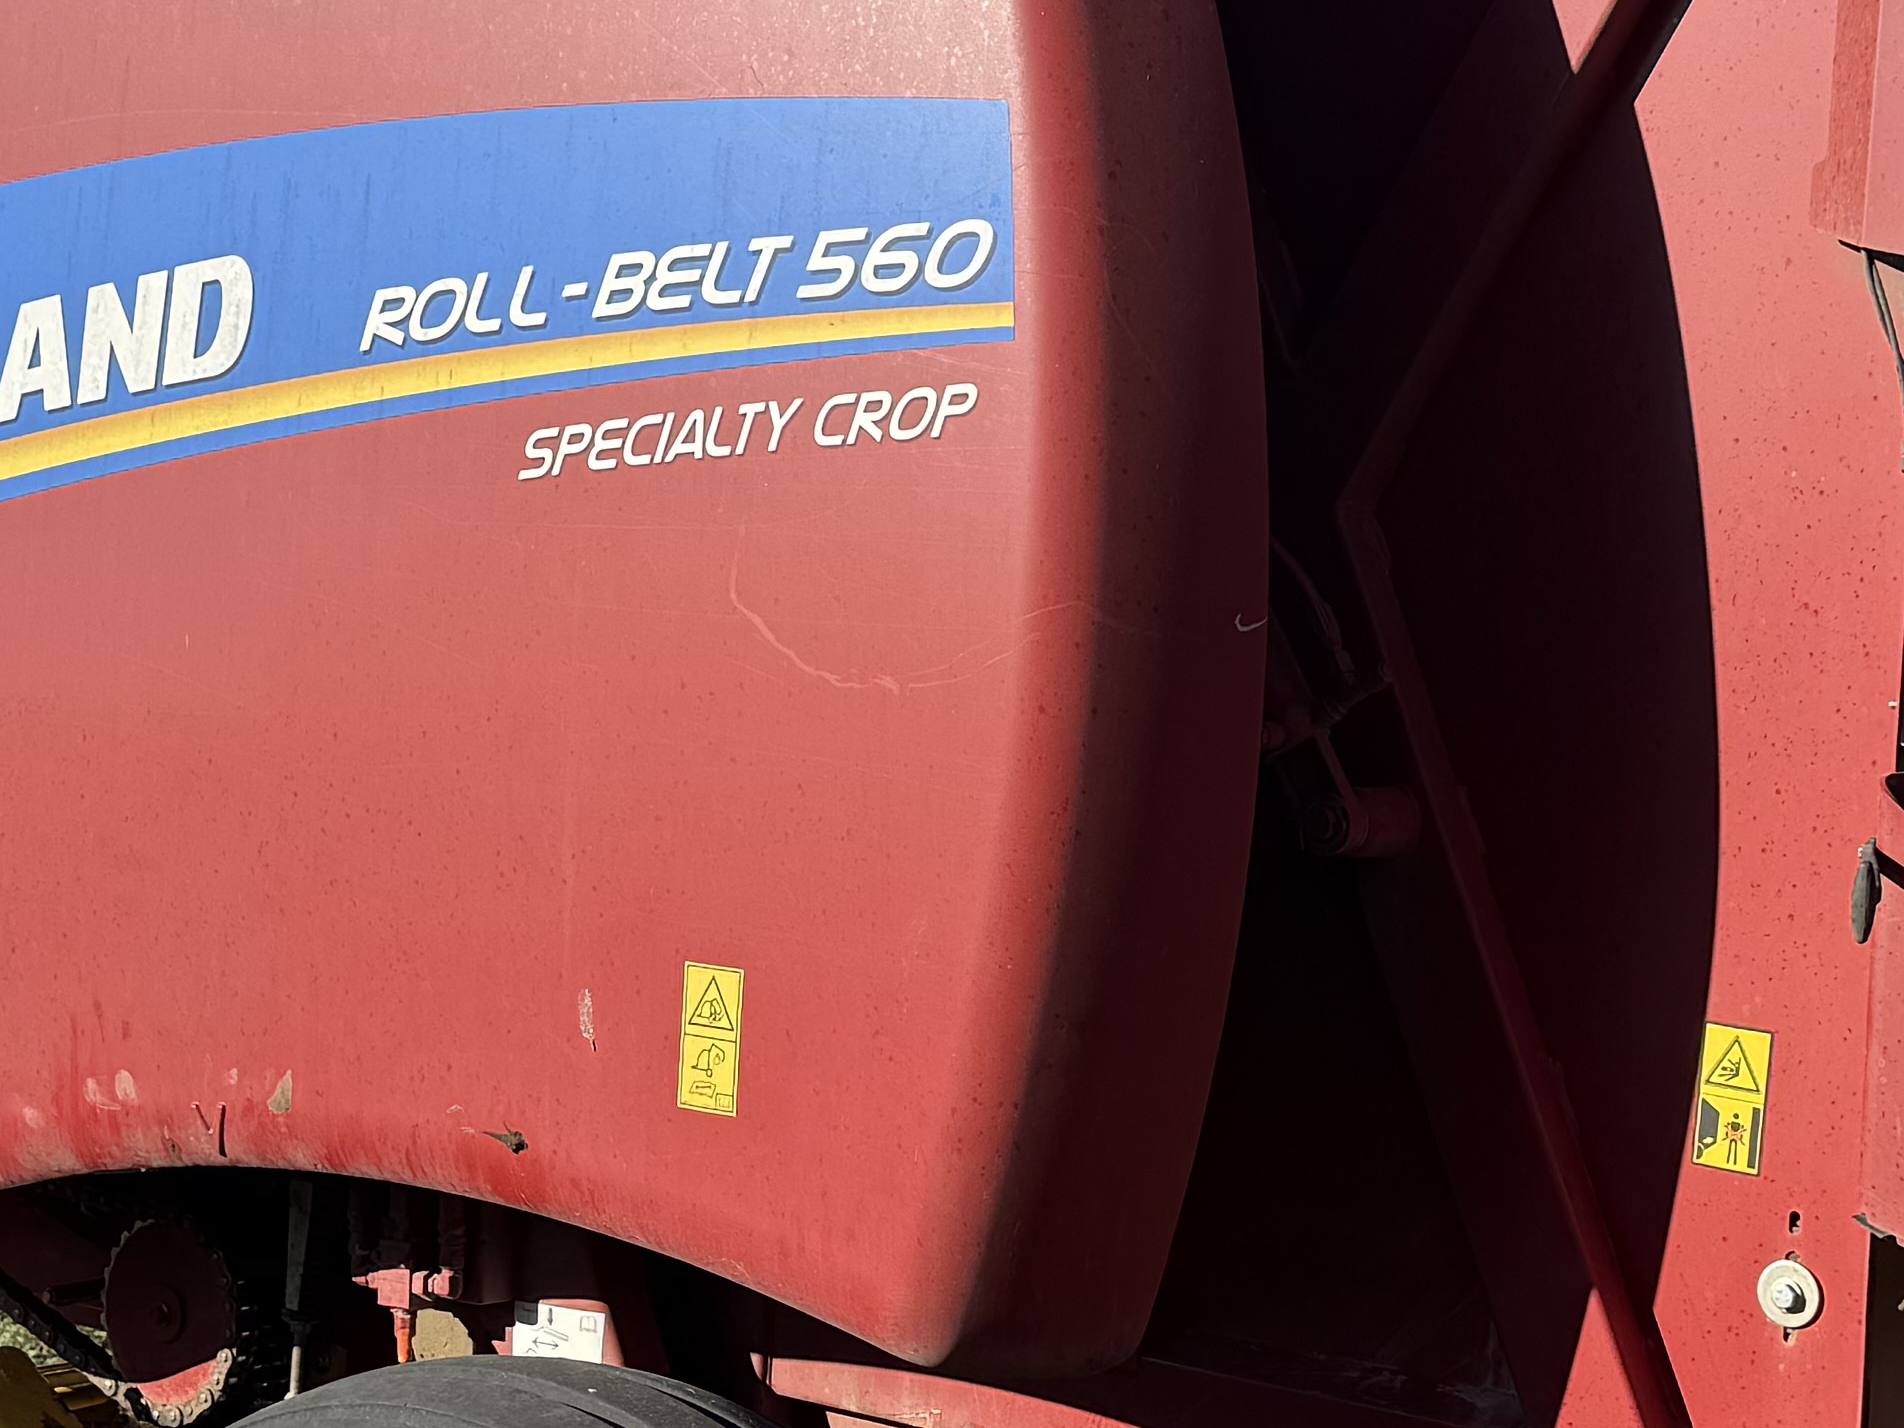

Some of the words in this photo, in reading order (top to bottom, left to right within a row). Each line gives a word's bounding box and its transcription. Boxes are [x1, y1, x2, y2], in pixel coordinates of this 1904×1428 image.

[359, 234, 795, 353] ROLL-BELT
[796, 219, 996, 301] 560
[517, 397, 804, 481] SPECIALTY
[813, 383, 979, 448] CROP
